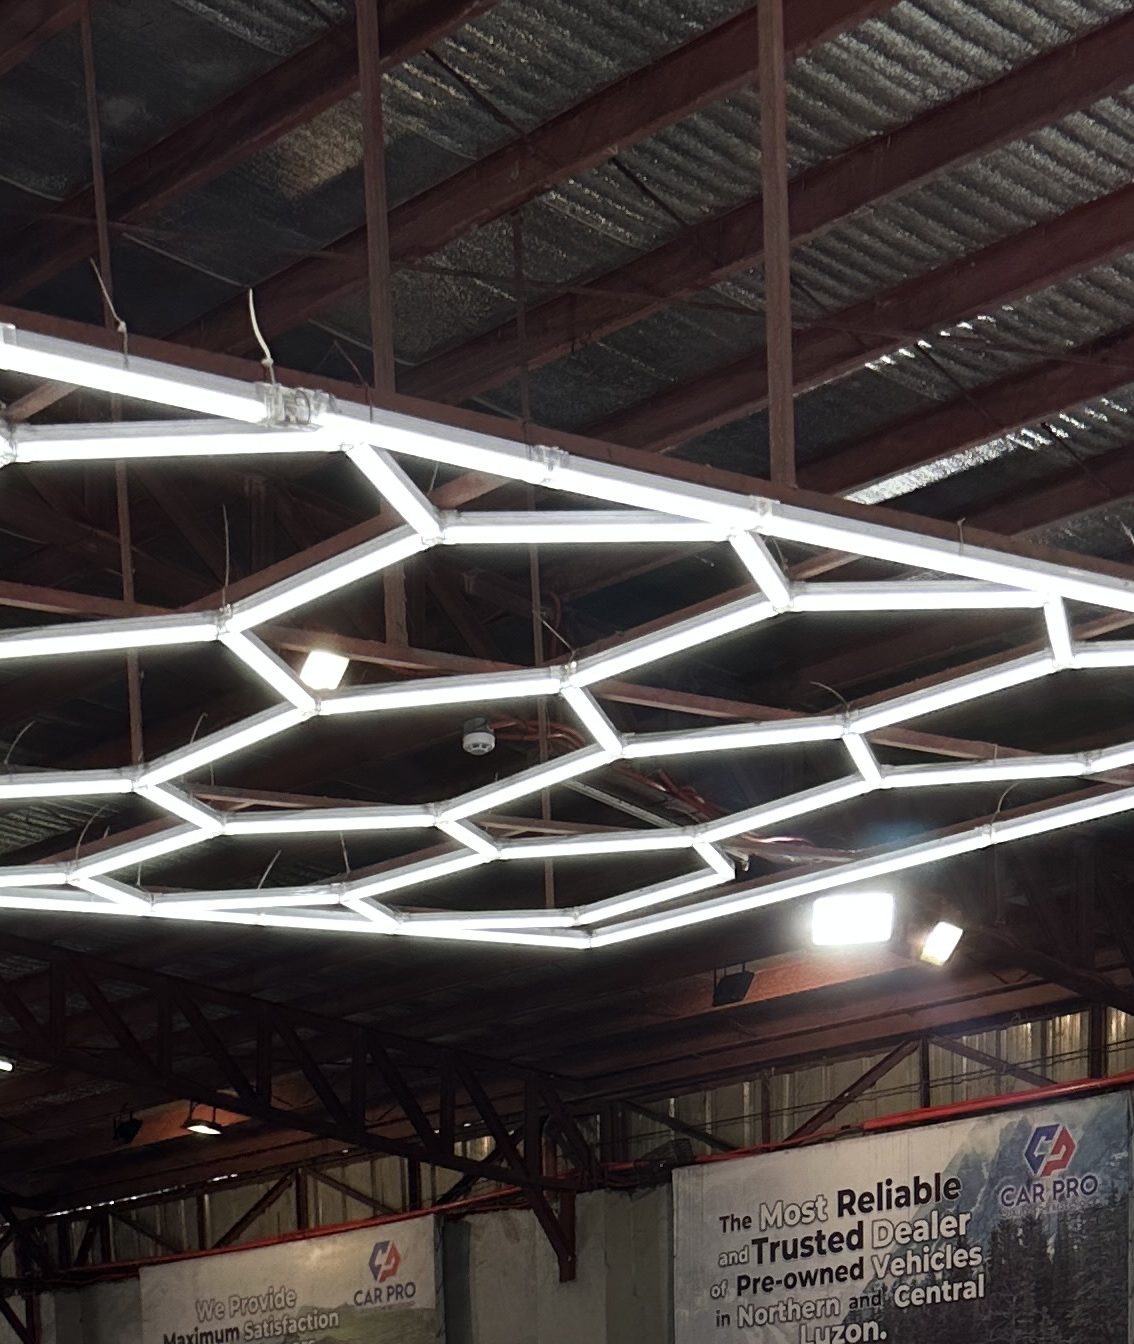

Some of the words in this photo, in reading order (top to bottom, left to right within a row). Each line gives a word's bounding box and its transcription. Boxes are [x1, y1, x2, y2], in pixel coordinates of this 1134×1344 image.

[718, 1213, 753, 1234] The
[759, 1195, 828, 1232] Most
[836, 1171, 963, 1218] Reliable
[1000, 1183, 1046, 1207] CAR
[1052, 1174, 1099, 1200] PRO
[718, 1244, 750, 1268] and
[751, 1220, 865, 1266] Trusted
[871, 1209, 972, 1250] Dealer
[353, 1287, 383, 1306] CAR
[386, 1281, 416, 1302] PRO
[710, 1281, 728, 1299] of
[736, 1255, 864, 1297] Pre-owned
[870, 1243, 983, 1279] Vehicles
[196, 1298, 225, 1323] We
[228, 1285, 298, 1318] Provide
[715, 1309, 731, 1328] in
[737, 1295, 841, 1329] Northern
[848, 1290, 882, 1311] and
[893, 1273, 985, 1309] Central
[243, 1309, 340, 1342] Satisfaction
